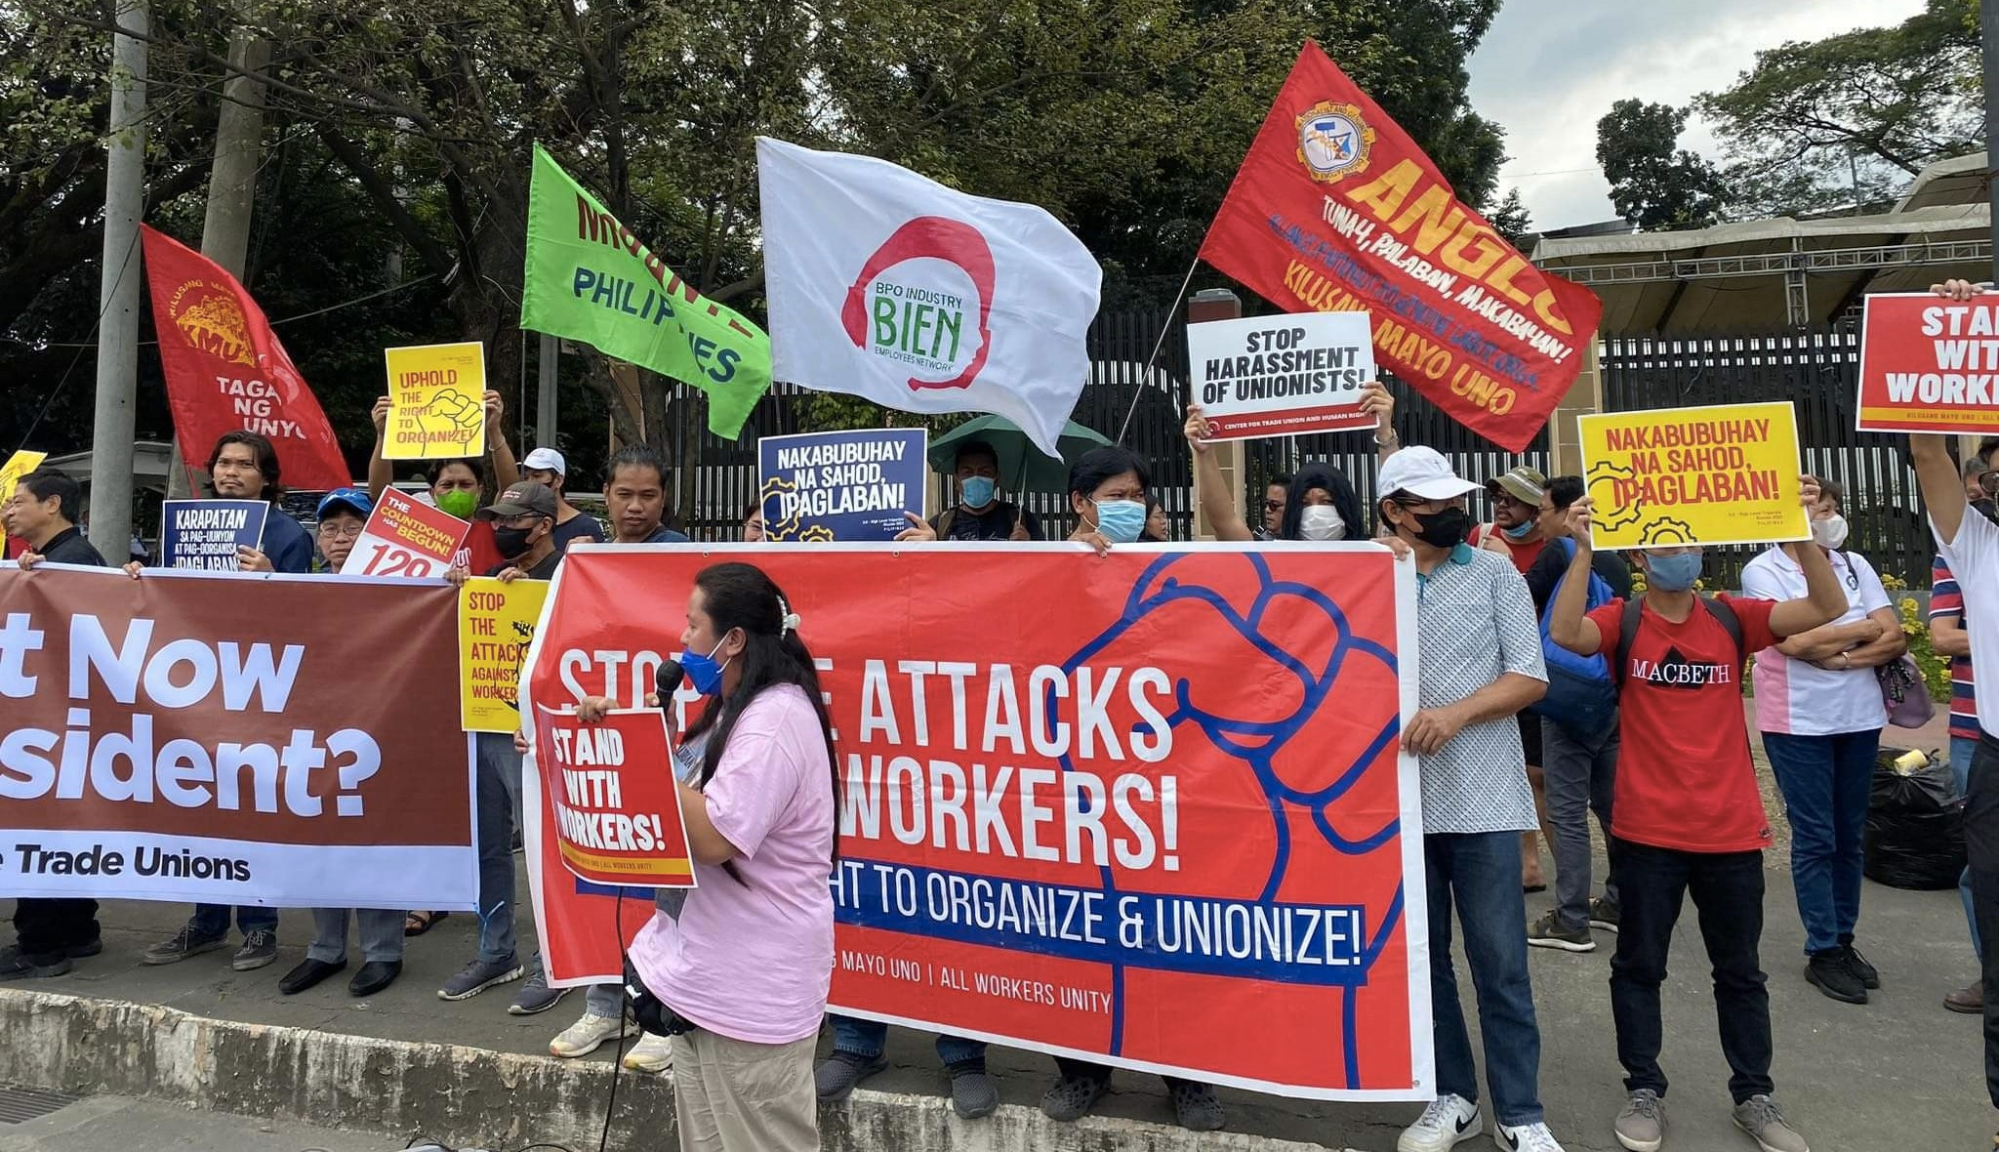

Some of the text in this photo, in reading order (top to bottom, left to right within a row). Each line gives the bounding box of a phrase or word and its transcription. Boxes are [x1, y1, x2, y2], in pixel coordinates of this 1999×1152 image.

[875, 282, 962, 309] BPO INDUSTRY
[1368, 232, 1458, 299] PALABAN,
[1454, 284, 1573, 364] MAKABAYAN!
[874, 296, 962, 362] BIEN
[1921, 306, 1999, 336] STA
[1246, 328, 1306, 353] STOP
[874, 346, 954, 372] EMPLOYEES NETWORK
[1206, 347, 1359, 381] HARASSMENT
[1373, 318, 1452, 380] MAYO
[1450, 363, 1516, 416] UNO
[400, 369, 457, 388] UPHOLD
[1203, 369, 1366, 404] OF UNIONISTS!
[234, 398, 271, 416] NG
[399, 405, 434, 417] RIGHT
[400, 391, 422, 404] THE
[396, 429, 474, 443] ORGANIZE!
[398, 419, 413, 429] TO
[1224, 422, 1248, 431] CENTER
[1262, 418, 1282, 427] TRADE
[1283, 416, 1304, 425] UNION
[1305, 415, 1321, 423] AND
[1322, 413, 1347, 421] HUMAN
[1606, 418, 1770, 451] NAKABUBUHAY
[778, 441, 906, 470] NAKABUBUHAY
[1631, 446, 1751, 475] NA SAHOD,
[794, 463, 886, 490] NA SAHOD,
[1613, 470, 1779, 508] IPAGLABAN!
[388, 497, 411, 513] THE
[780, 483, 905, 520] IPAGLABAN!
[175, 509, 247, 529] KARAPATAN
[380, 506, 455, 545] COUNTDOWN
[175, 543, 183, 555] AT
[180, 530, 235, 542] SA PAG-UUNYON
[382, 517, 450, 556] HAS BEGUN!
[176, 556, 239, 572] IPAGLABAN
[469, 592, 505, 611] STOP
[469, 617, 497, 636] THE
[69, 613, 305, 713] Now
[471, 643, 528, 662] ATTACK
[472, 667, 517, 682] AGAINST
[1632, 658, 1731, 685] MACBETH
[472, 684, 518, 700] WORKER
[859, 658, 1174, 762] ATTACKS
[551, 728, 624, 766] STAND
[562, 768, 622, 809] WITH
[557, 800, 666, 852] WORKERS!
[838, 752, 1179, 872] WORKERS!
[15, 844, 124, 876] Trade
[134, 846, 251, 882] Unions
[873, 864, 917, 918] TO
[926, 873, 1107, 945] ORGANIZE
[1118, 896, 1143, 950] &
[1156, 897, 1361, 967] UNIONIZE!
[842, 950, 886, 978] MAYO
[890, 957, 922, 984] UNO
[939, 964, 968, 991] ALL
[974, 973, 1054, 1006] WORKERS
[1060, 986, 1112, 1014] UNITY
